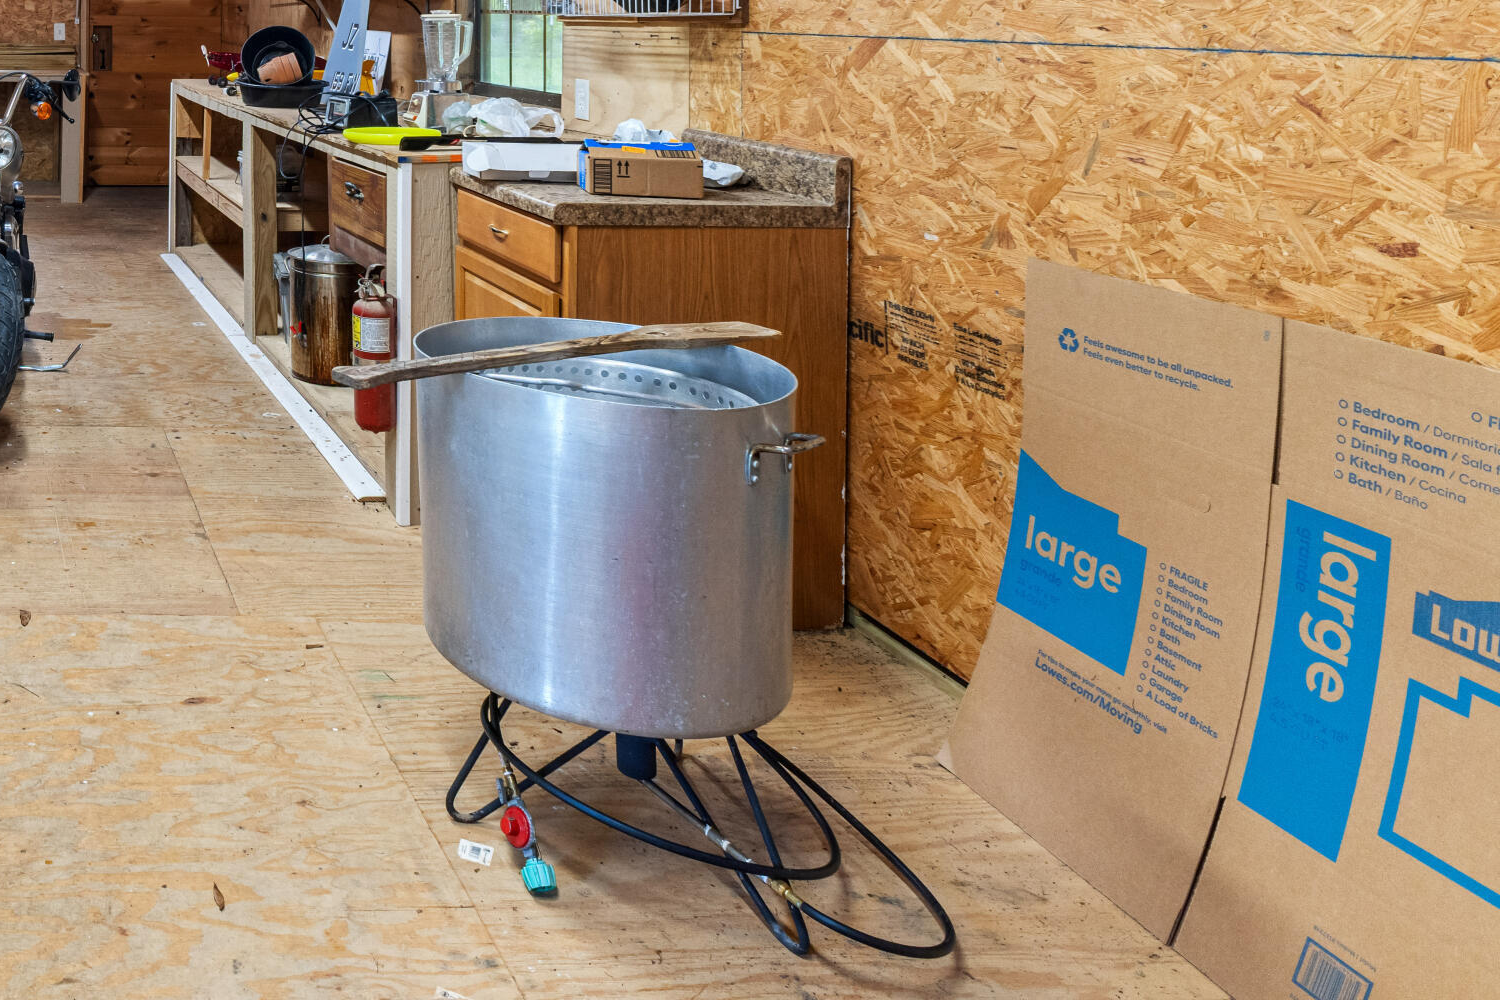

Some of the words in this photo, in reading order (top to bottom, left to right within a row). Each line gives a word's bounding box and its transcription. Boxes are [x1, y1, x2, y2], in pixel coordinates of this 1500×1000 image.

[342, 22, 360, 52] JZ
[1083, 335, 1104, 349] Feels
[1105, 343, 1145, 361] awesome
[1147, 355, 1156, 365] to
[1157, 357, 1169, 369] be
[1170, 362, 1182, 373] all
[1183, 366, 1234, 389] unpacked.
[1083, 347, 1103, 361] Feels
[1105, 355, 1124, 368] even
[1125, 360, 1152, 376] better
[1154, 370, 1164, 380] to
[1165, 373, 1201, 392] recycle.
[1353, 401, 1420, 432] Bedroom
[1351, 437, 1398, 464] Dining
[1401, 453, 1445, 478] Room
[1352, 419, 1400, 446] Family
[1403, 434, 1448, 460] Room
[1461, 454, 1492, 473] Sala
[1348, 472, 1382, 494] Bath
[1394, 490, 1429, 510] Baño
[1350, 454, 1406, 484] Kitchen
[1418, 479, 1467, 505] Cocina
[1025, 514, 1122, 594] large
[1168, 579, 1209, 605] Bedroom
[1169, 566, 1209, 592] FRAGILE
[1164, 603, 1193, 627] Dining
[1194, 619, 1221, 640] Room
[1166, 591, 1195, 613] Family
[1196, 607, 1223, 627] Room
[1298, 530, 1377, 703] large
[1159, 628, 1181, 646] Bath
[1161, 615, 1196, 641] Kitchen
[1154, 653, 1177, 672] Attic
[1157, 640, 1203, 672] Basement
[1035, 656, 1143, 735] Lowes.com/Moving
[1150, 678, 1184, 704] Garage
[1152, 665, 1189, 694] Laundry
[1146, 689, 1153, 701] A
[1155, 694, 1178, 715] Load
[1178, 710, 1189, 721] of
[1189, 715, 1219, 740] Bricks
[1152, 721, 1168, 735] visit
